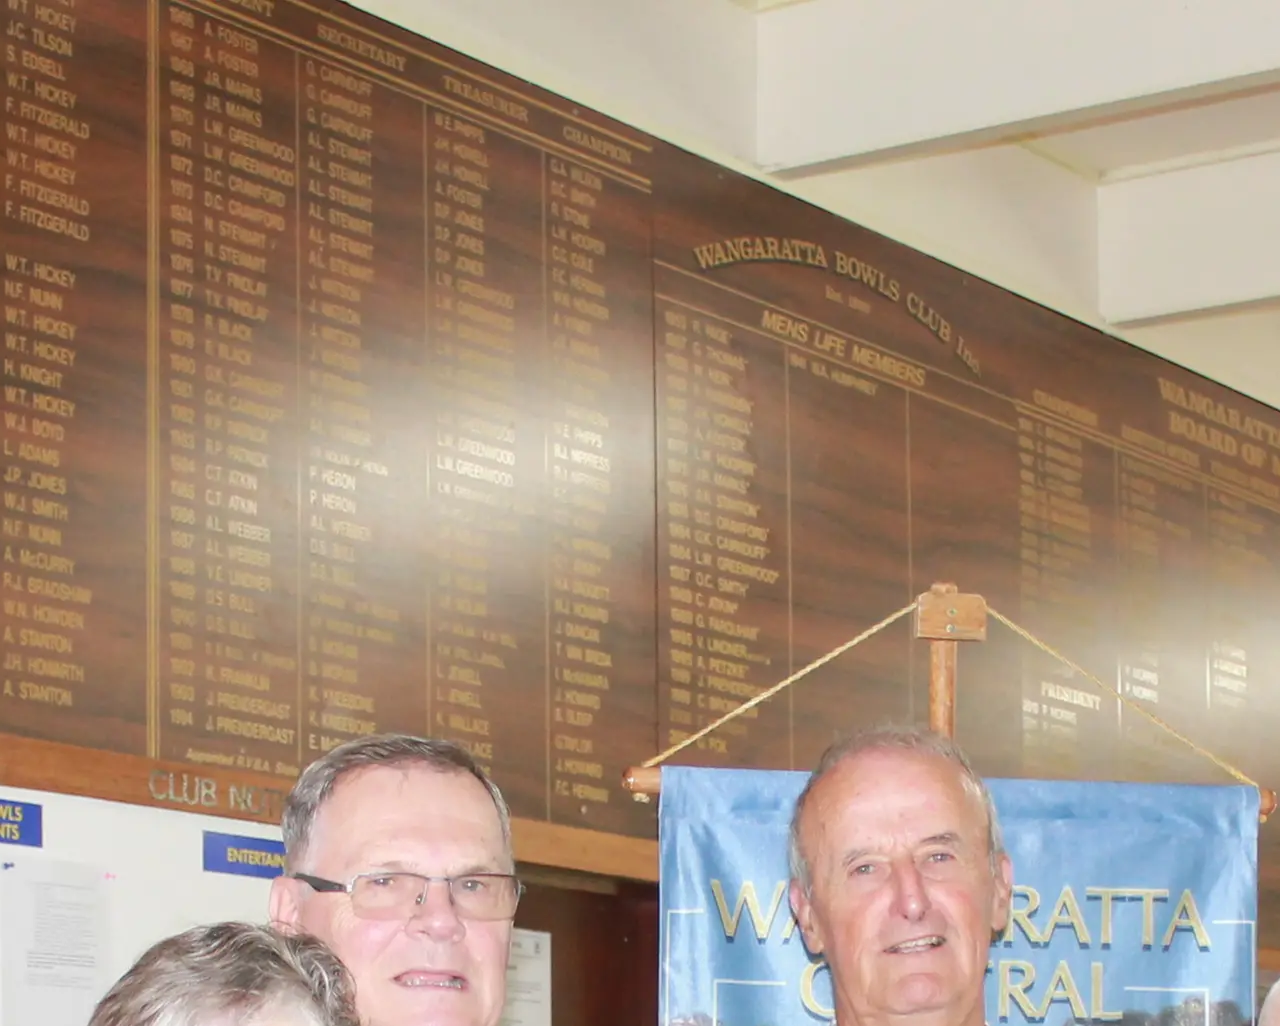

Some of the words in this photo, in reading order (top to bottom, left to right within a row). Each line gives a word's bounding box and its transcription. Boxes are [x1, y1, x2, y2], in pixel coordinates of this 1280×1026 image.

[218, 26, 259, 54] FOSTER
[318, 25, 407, 72] SECRETARY
[443, 74, 529, 122] TREASURER
[20, 101, 90, 140] FITZGERALD
[562, 125, 632, 165] CHAMPION
[33, 262, 76, 288] HICKEY
[692, 236, 828, 269] WANGARATTA
[834, 250, 901, 302] BOWLS
[906, 291, 952, 343] CLUB
[760, 309, 810, 344] MENS
[814, 331, 847, 358] LIFE
[851, 343, 926, 387] MEMBERS
[19, 363, 63, 389] KNIGHT
[1169, 410, 1238, 457] BOARD
[1240, 441, 1269, 470] OF
[19, 681, 73, 707] STANTON
[1040, 680, 1103, 712] PRESIDENT
[215, 715, 296, 745] PRENDERGAST
[148, 769, 218, 808] CLUB
[226, 846, 286, 868] ENTERTAIN
[710, 878, 1212, 950] WRATTA
[800, 958, 1124, 1021] CRAL
